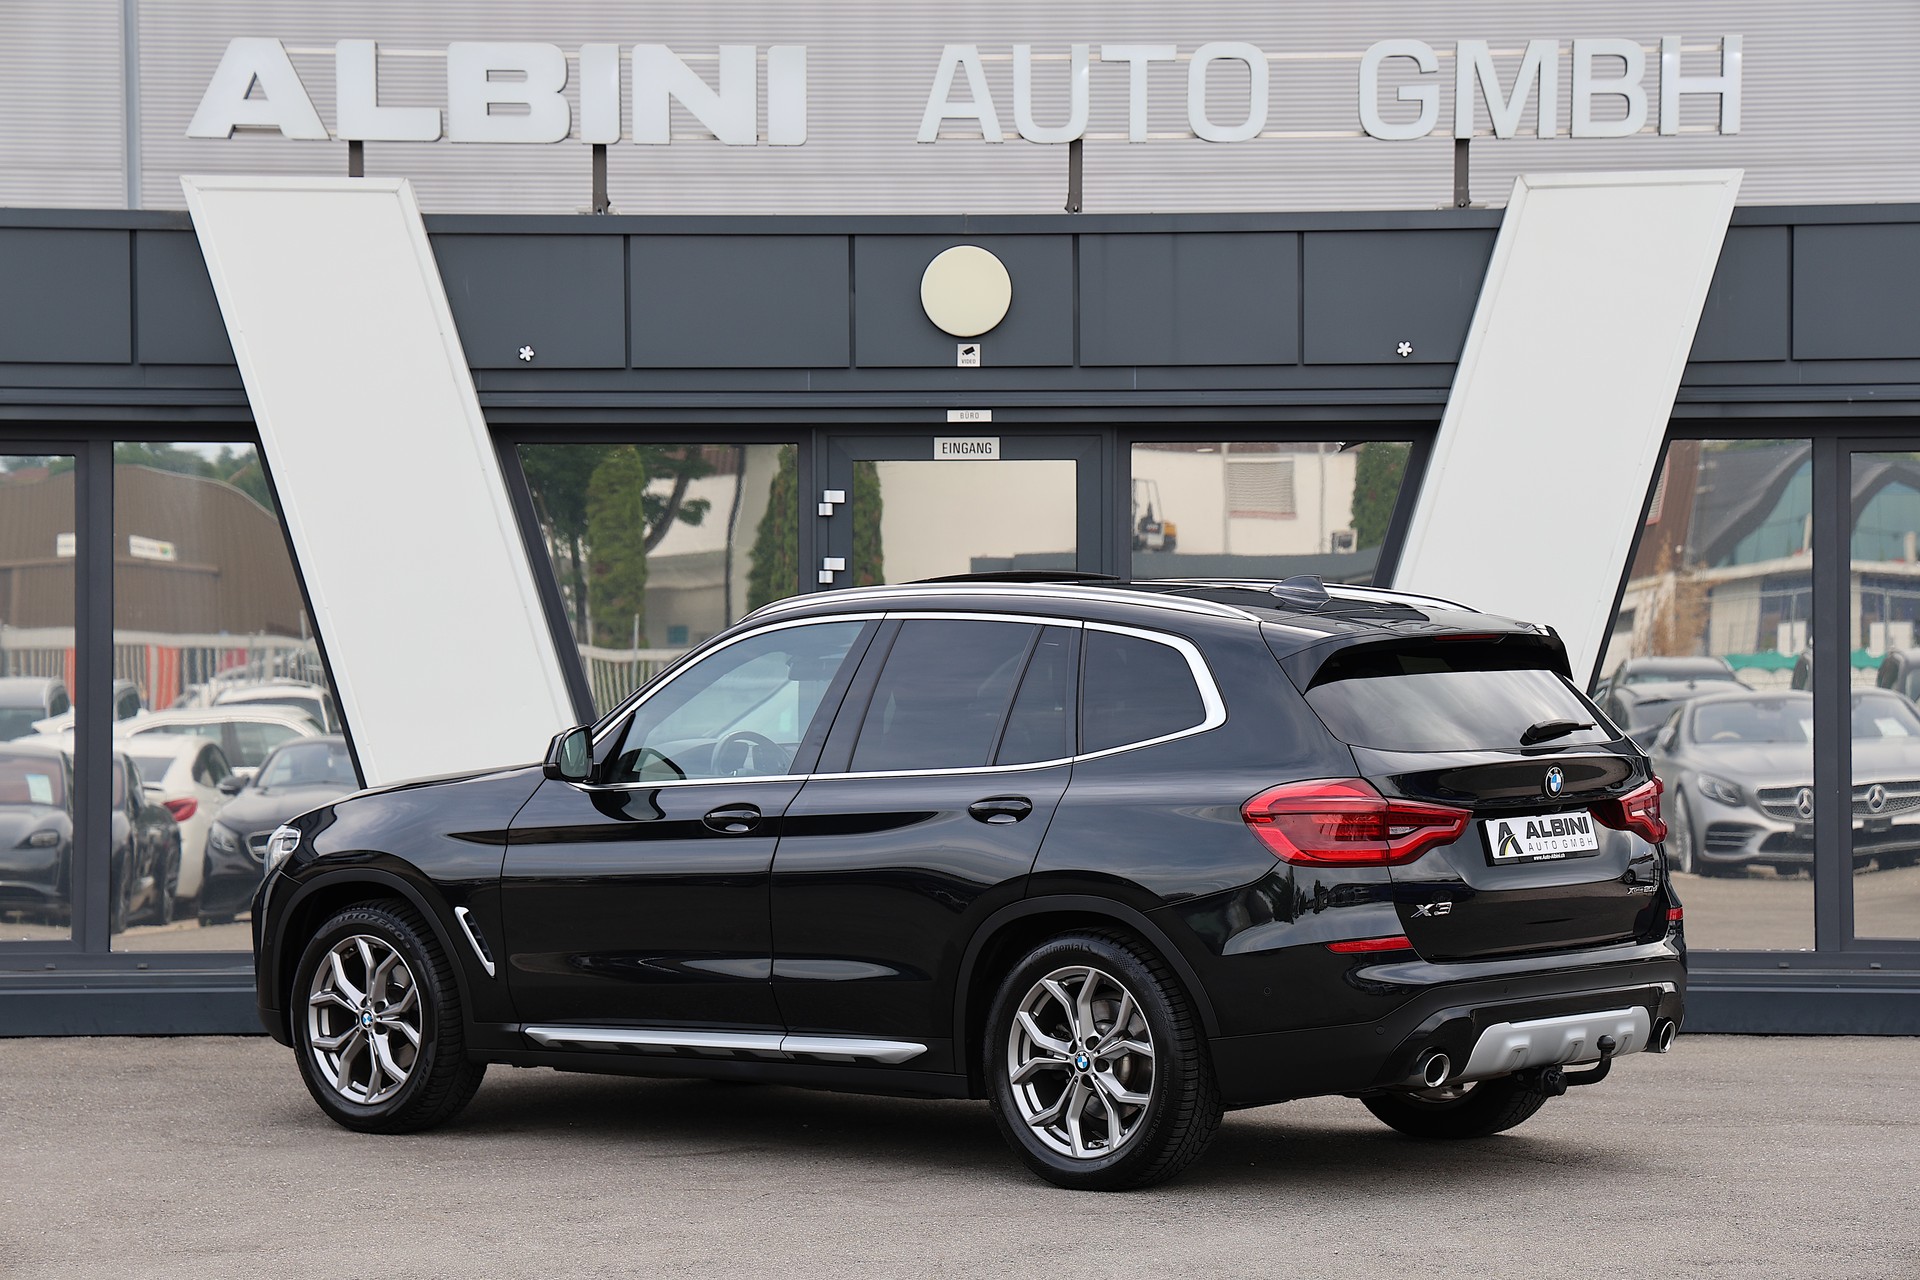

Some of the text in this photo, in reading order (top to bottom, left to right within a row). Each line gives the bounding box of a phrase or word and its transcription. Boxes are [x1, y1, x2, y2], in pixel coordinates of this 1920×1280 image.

[185, 35, 1744, 146] ALBINI AUTO GMBH
[959, 411, 980, 419] BÜRO
[942, 442, 992, 454] EINGANG
[1526, 816, 1590, 839] ALBINI
[1528, 837, 1594, 852] AUTO GMBH
[1410, 901, 1453, 918] X3
